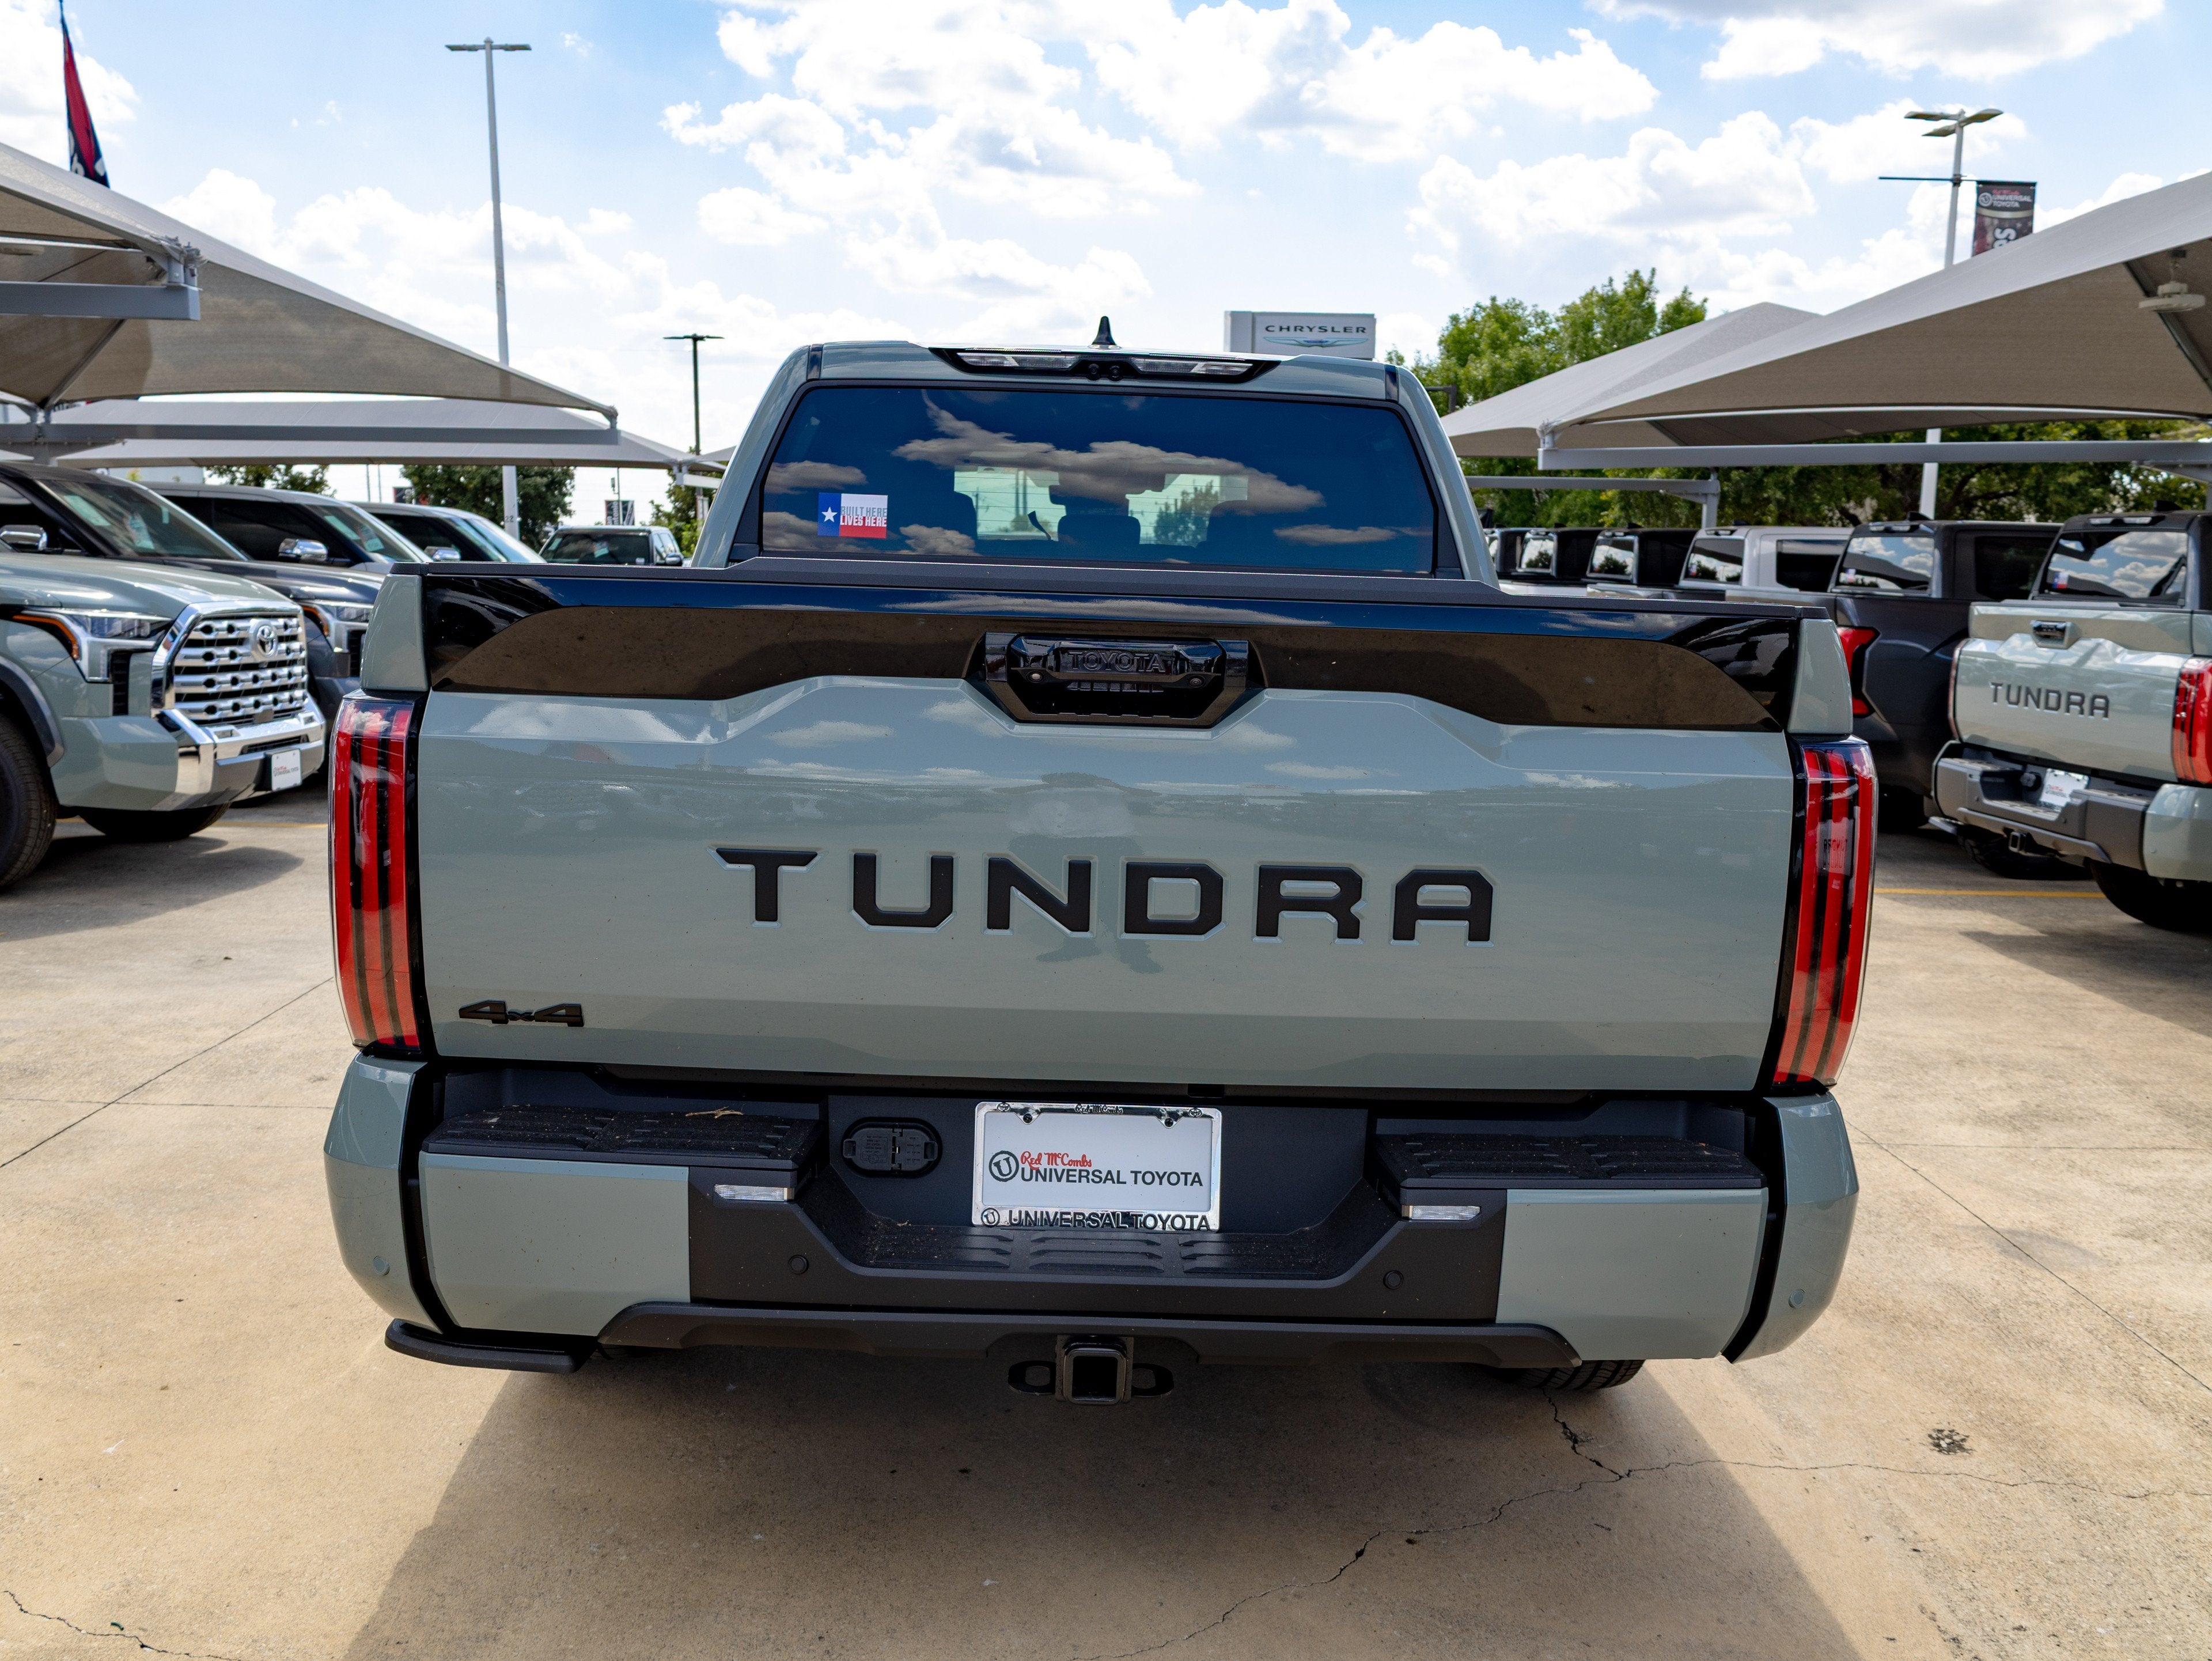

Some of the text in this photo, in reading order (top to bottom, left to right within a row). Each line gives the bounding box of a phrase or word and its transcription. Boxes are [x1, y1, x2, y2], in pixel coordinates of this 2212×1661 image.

[1265, 325, 1366, 334] CHRYSLER
[841, 506, 887, 517] BUILT HERE
[840, 516, 887, 527] LIVES HERE
[1069, 651, 1165, 672] TOYOTA
[1991, 682, 2109, 720] TUNDRA
[714, 847, 1495, 943] TUNDRA
[1075, 1103, 1089, 1114] Red
[1021, 1151, 1043, 1170] Red
[1021, 1168, 1127, 1185] UNIVERSAL
[1130, 1170, 1203, 1187] TOYOTA
[1009, 1210, 1128, 1228] UNIVERSAL
[1131, 1213, 1210, 1231] TOYOTA
